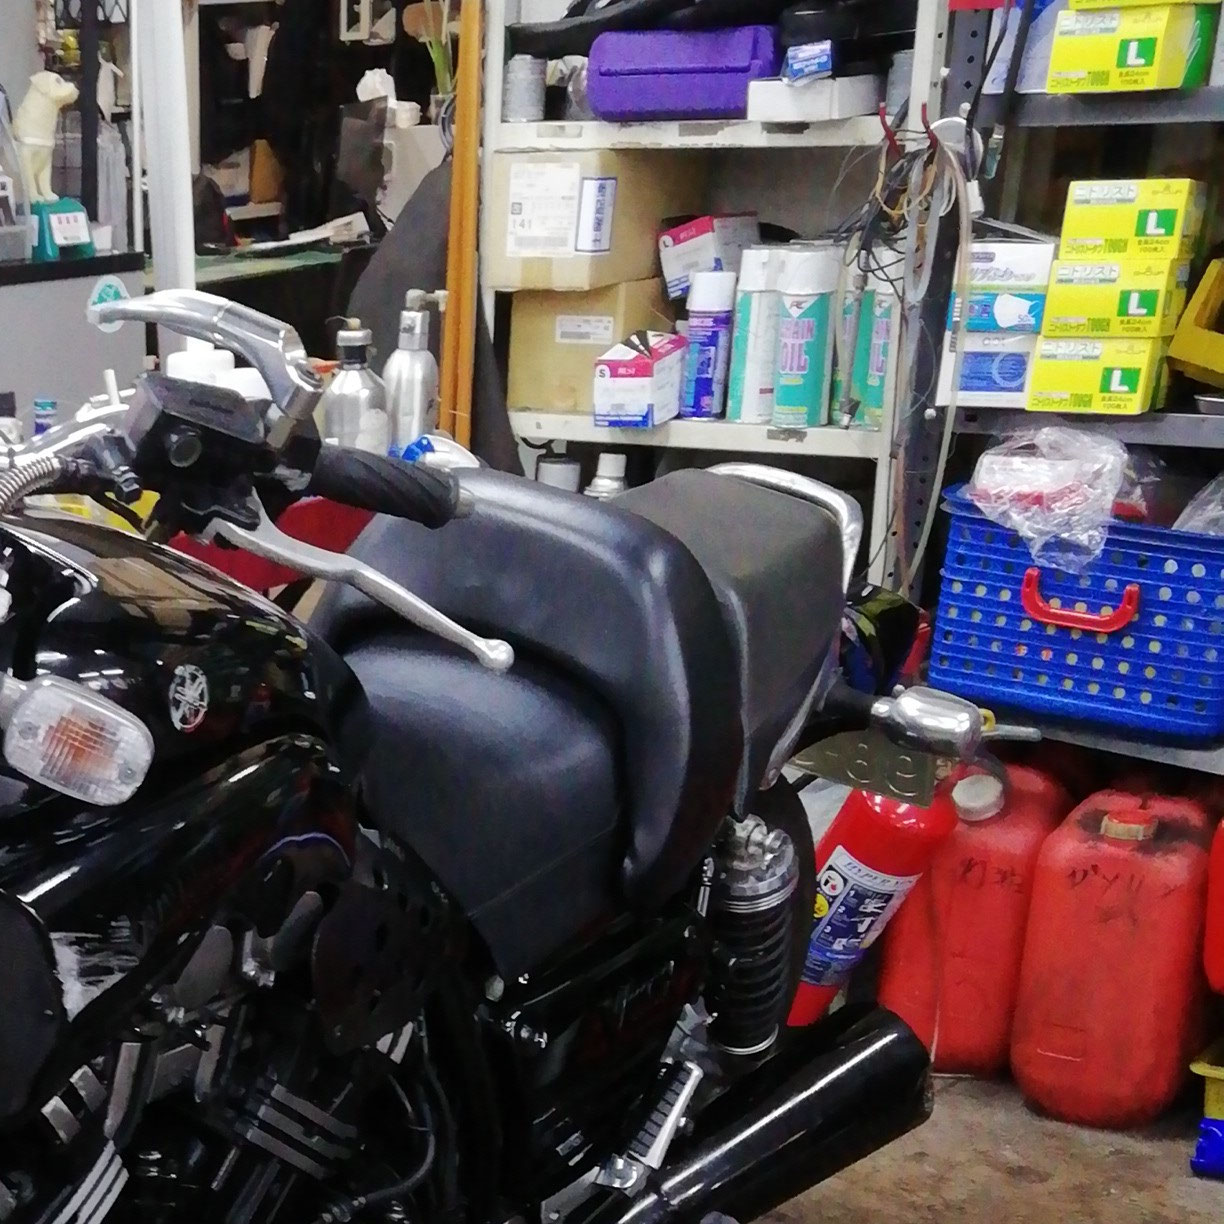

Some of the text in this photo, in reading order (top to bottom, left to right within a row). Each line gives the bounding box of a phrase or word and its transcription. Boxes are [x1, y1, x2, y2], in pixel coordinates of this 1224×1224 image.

[1059, 12, 1118, 29] ニトリスト
[1127, 41, 1146, 65] L
[1075, 187, 1135, 198] ニトリスト
[1146, 211, 1166, 235] L
[1059, 266, 1117, 277] ニトリスト
[1128, 292, 1148, 315] L
[1043, 341, 1100, 353] ニトリスト
[599, 368, 606, 379] S
[1110, 369, 1130, 391] L
